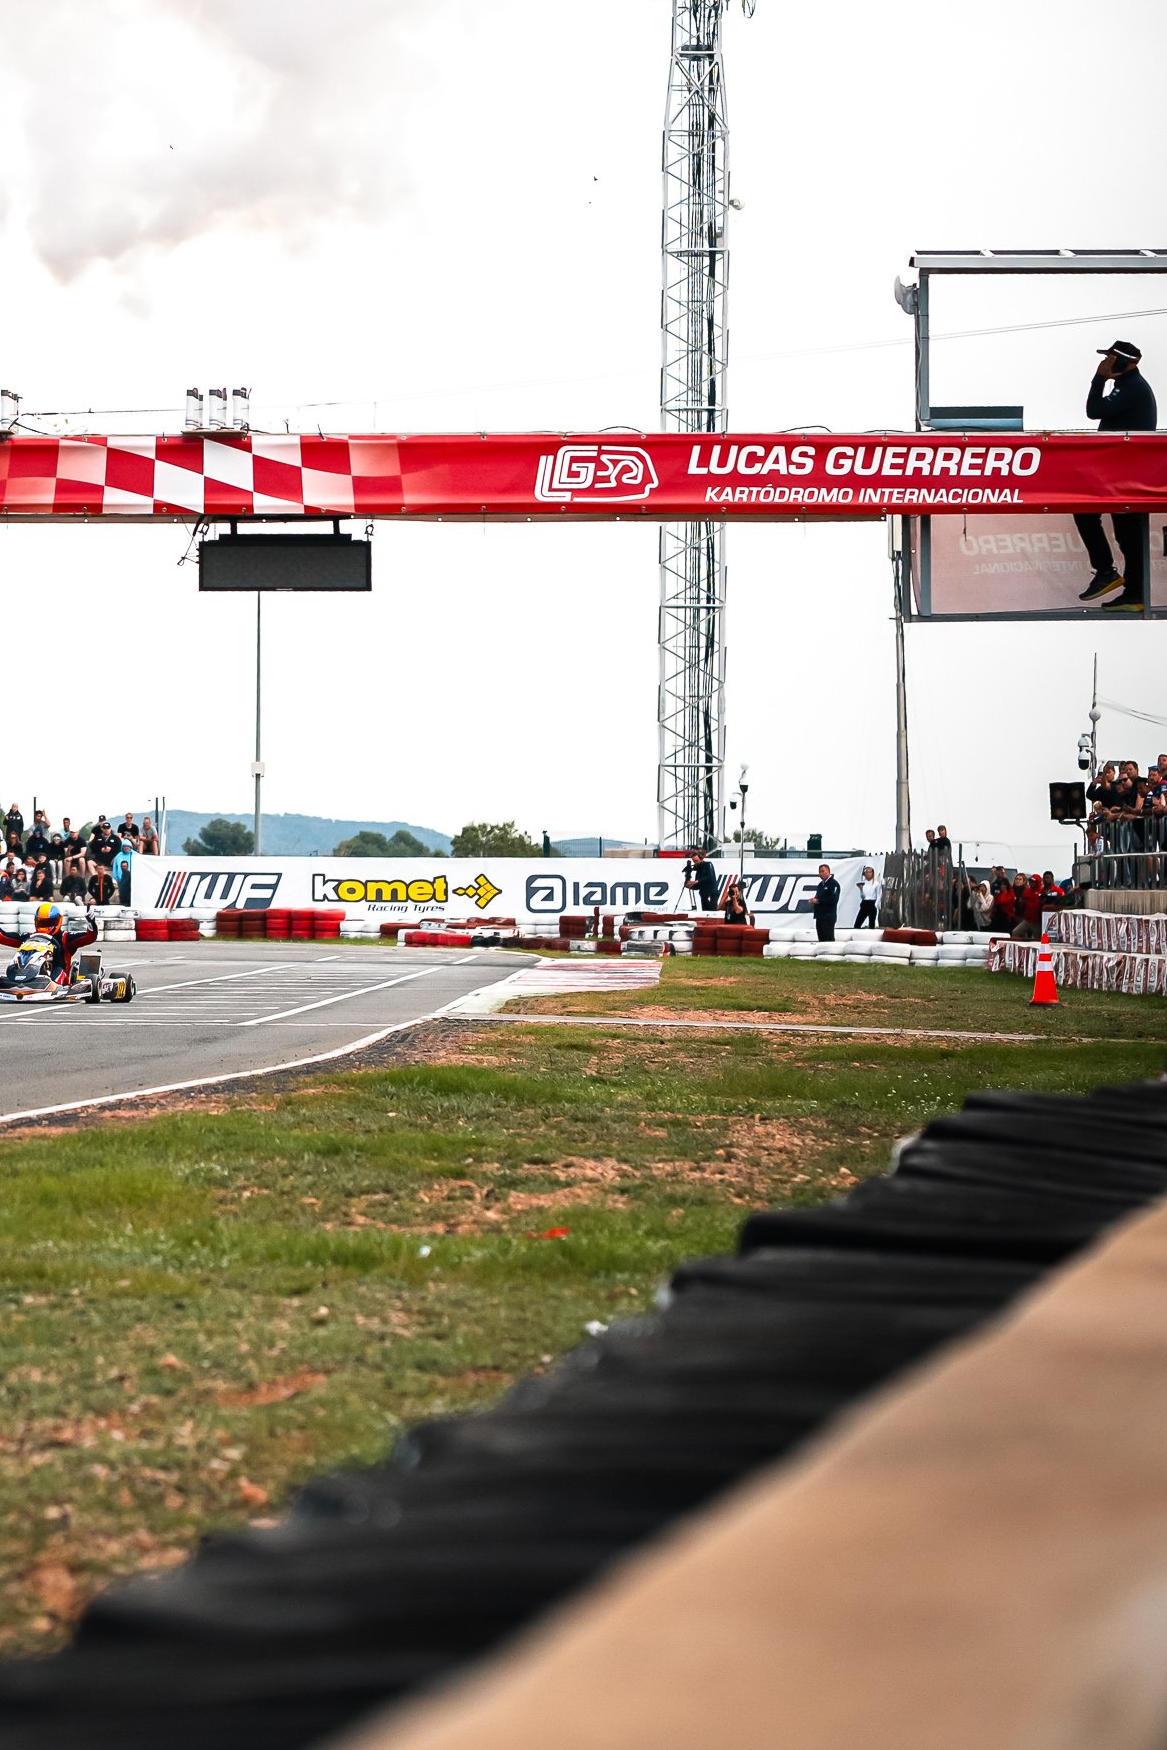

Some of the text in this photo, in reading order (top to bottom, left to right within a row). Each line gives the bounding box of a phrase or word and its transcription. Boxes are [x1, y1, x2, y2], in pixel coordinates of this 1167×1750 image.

[687, 444, 1042, 477] LUCAS GUERRERO
[704, 483, 1025, 505] KARTÓDROMO INTERNACIONAL
[180, 874, 280, 909] IWF
[312, 873, 448, 902] komet
[367, 903, 446, 914] Racing Tyres
